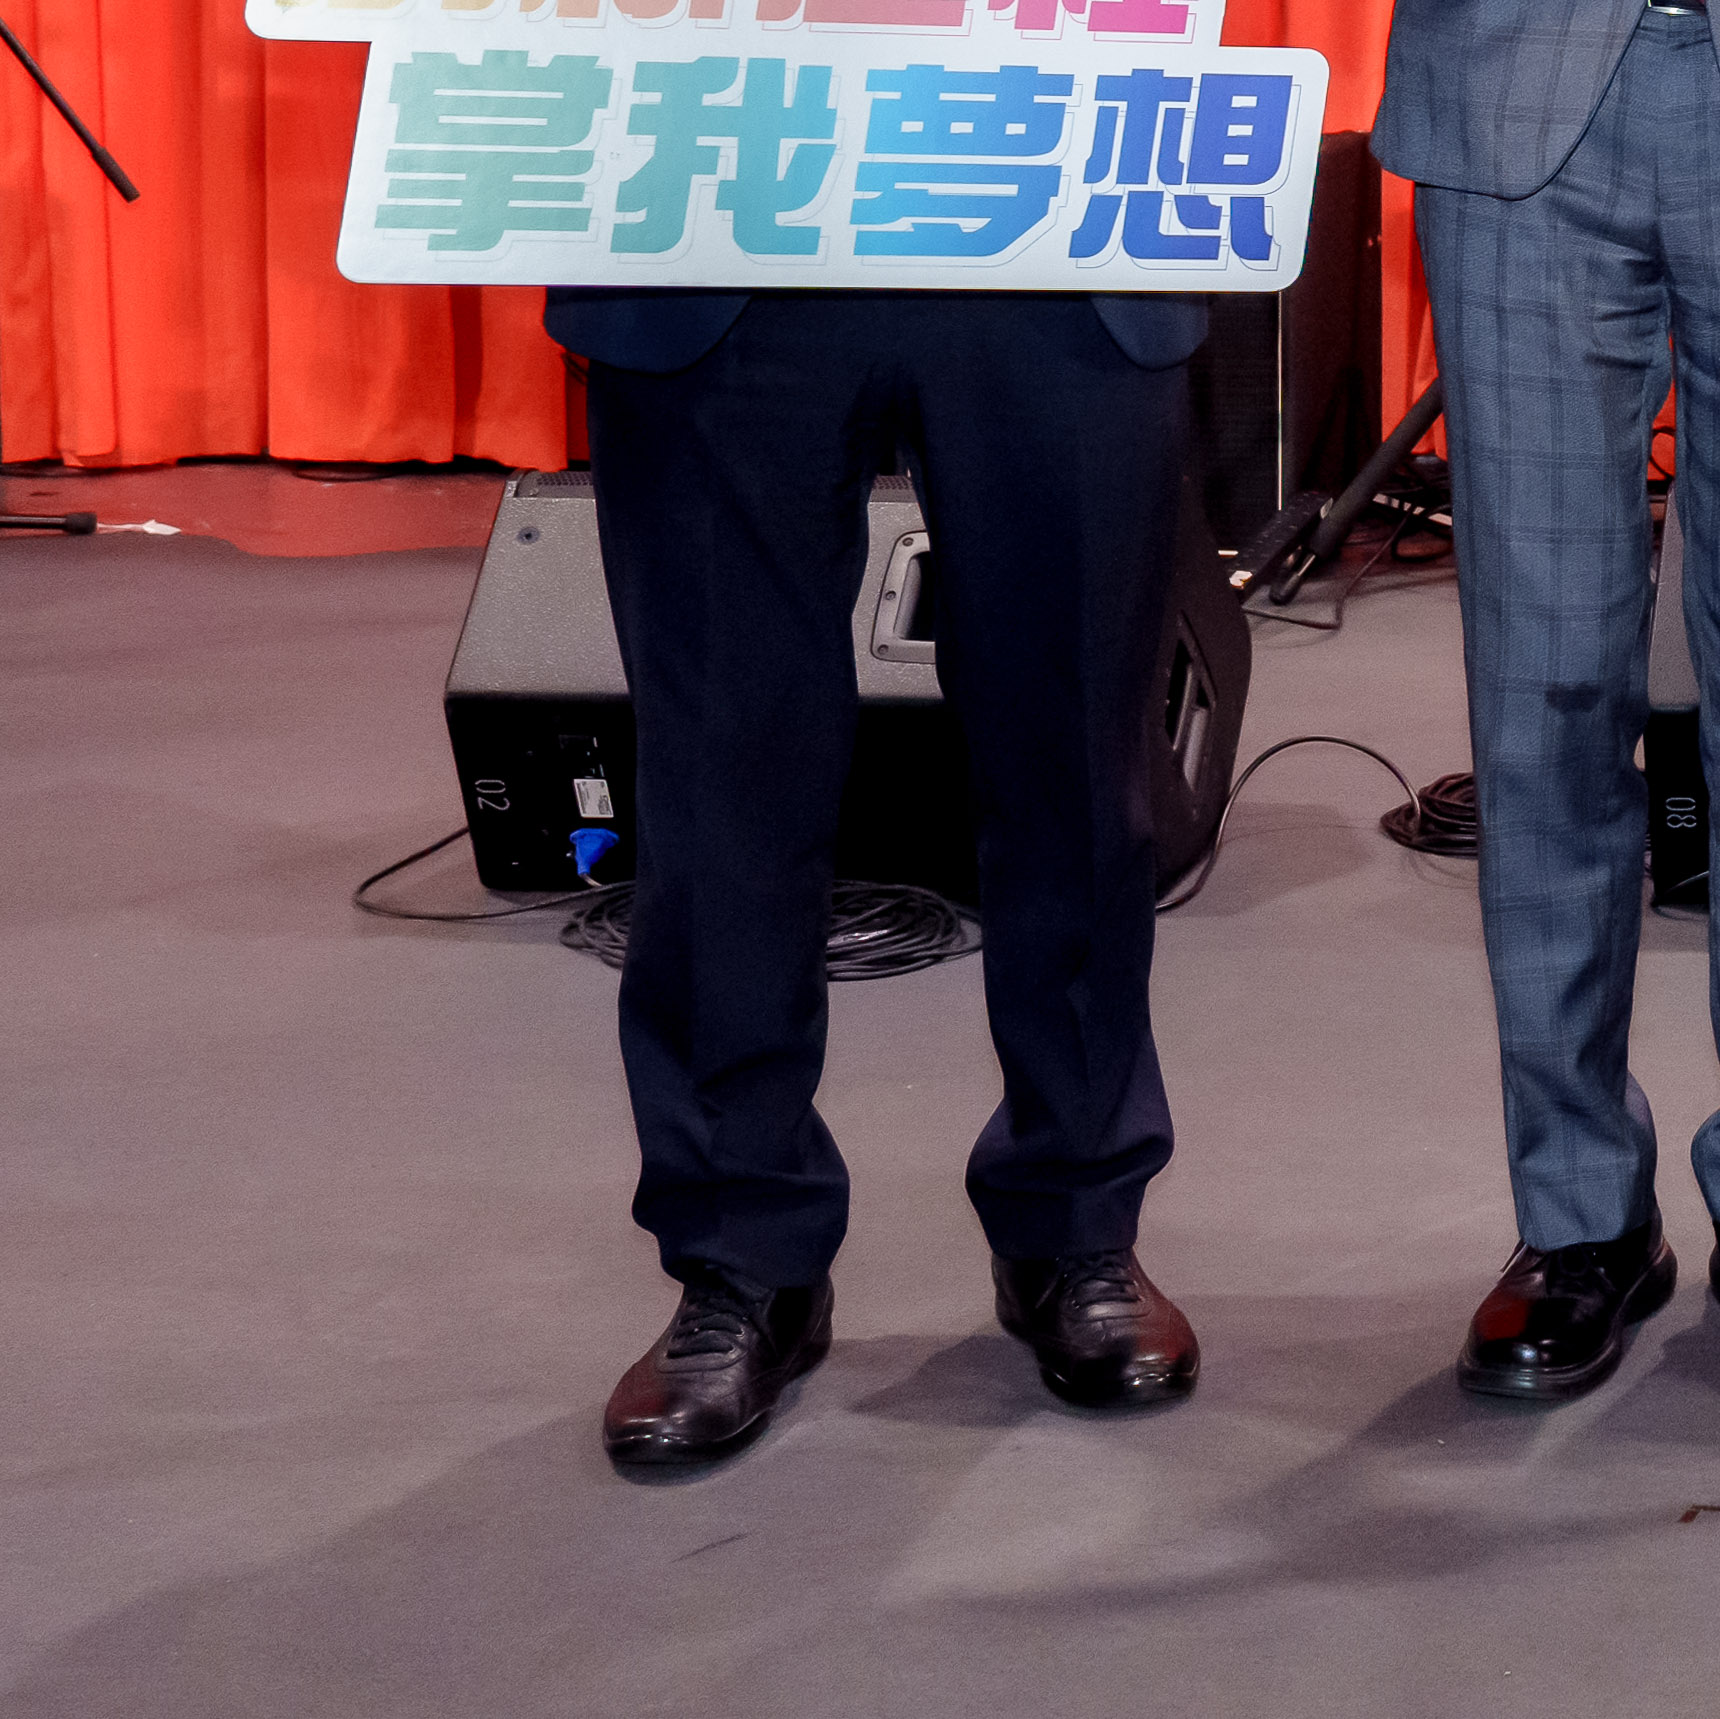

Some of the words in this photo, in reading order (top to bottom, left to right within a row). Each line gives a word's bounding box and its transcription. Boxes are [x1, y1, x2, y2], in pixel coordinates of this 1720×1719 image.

[374, 48, 1293, 262] 掌我夢想
[475, 779, 511, 811] 02
[1665, 797, 1697, 828] 08
